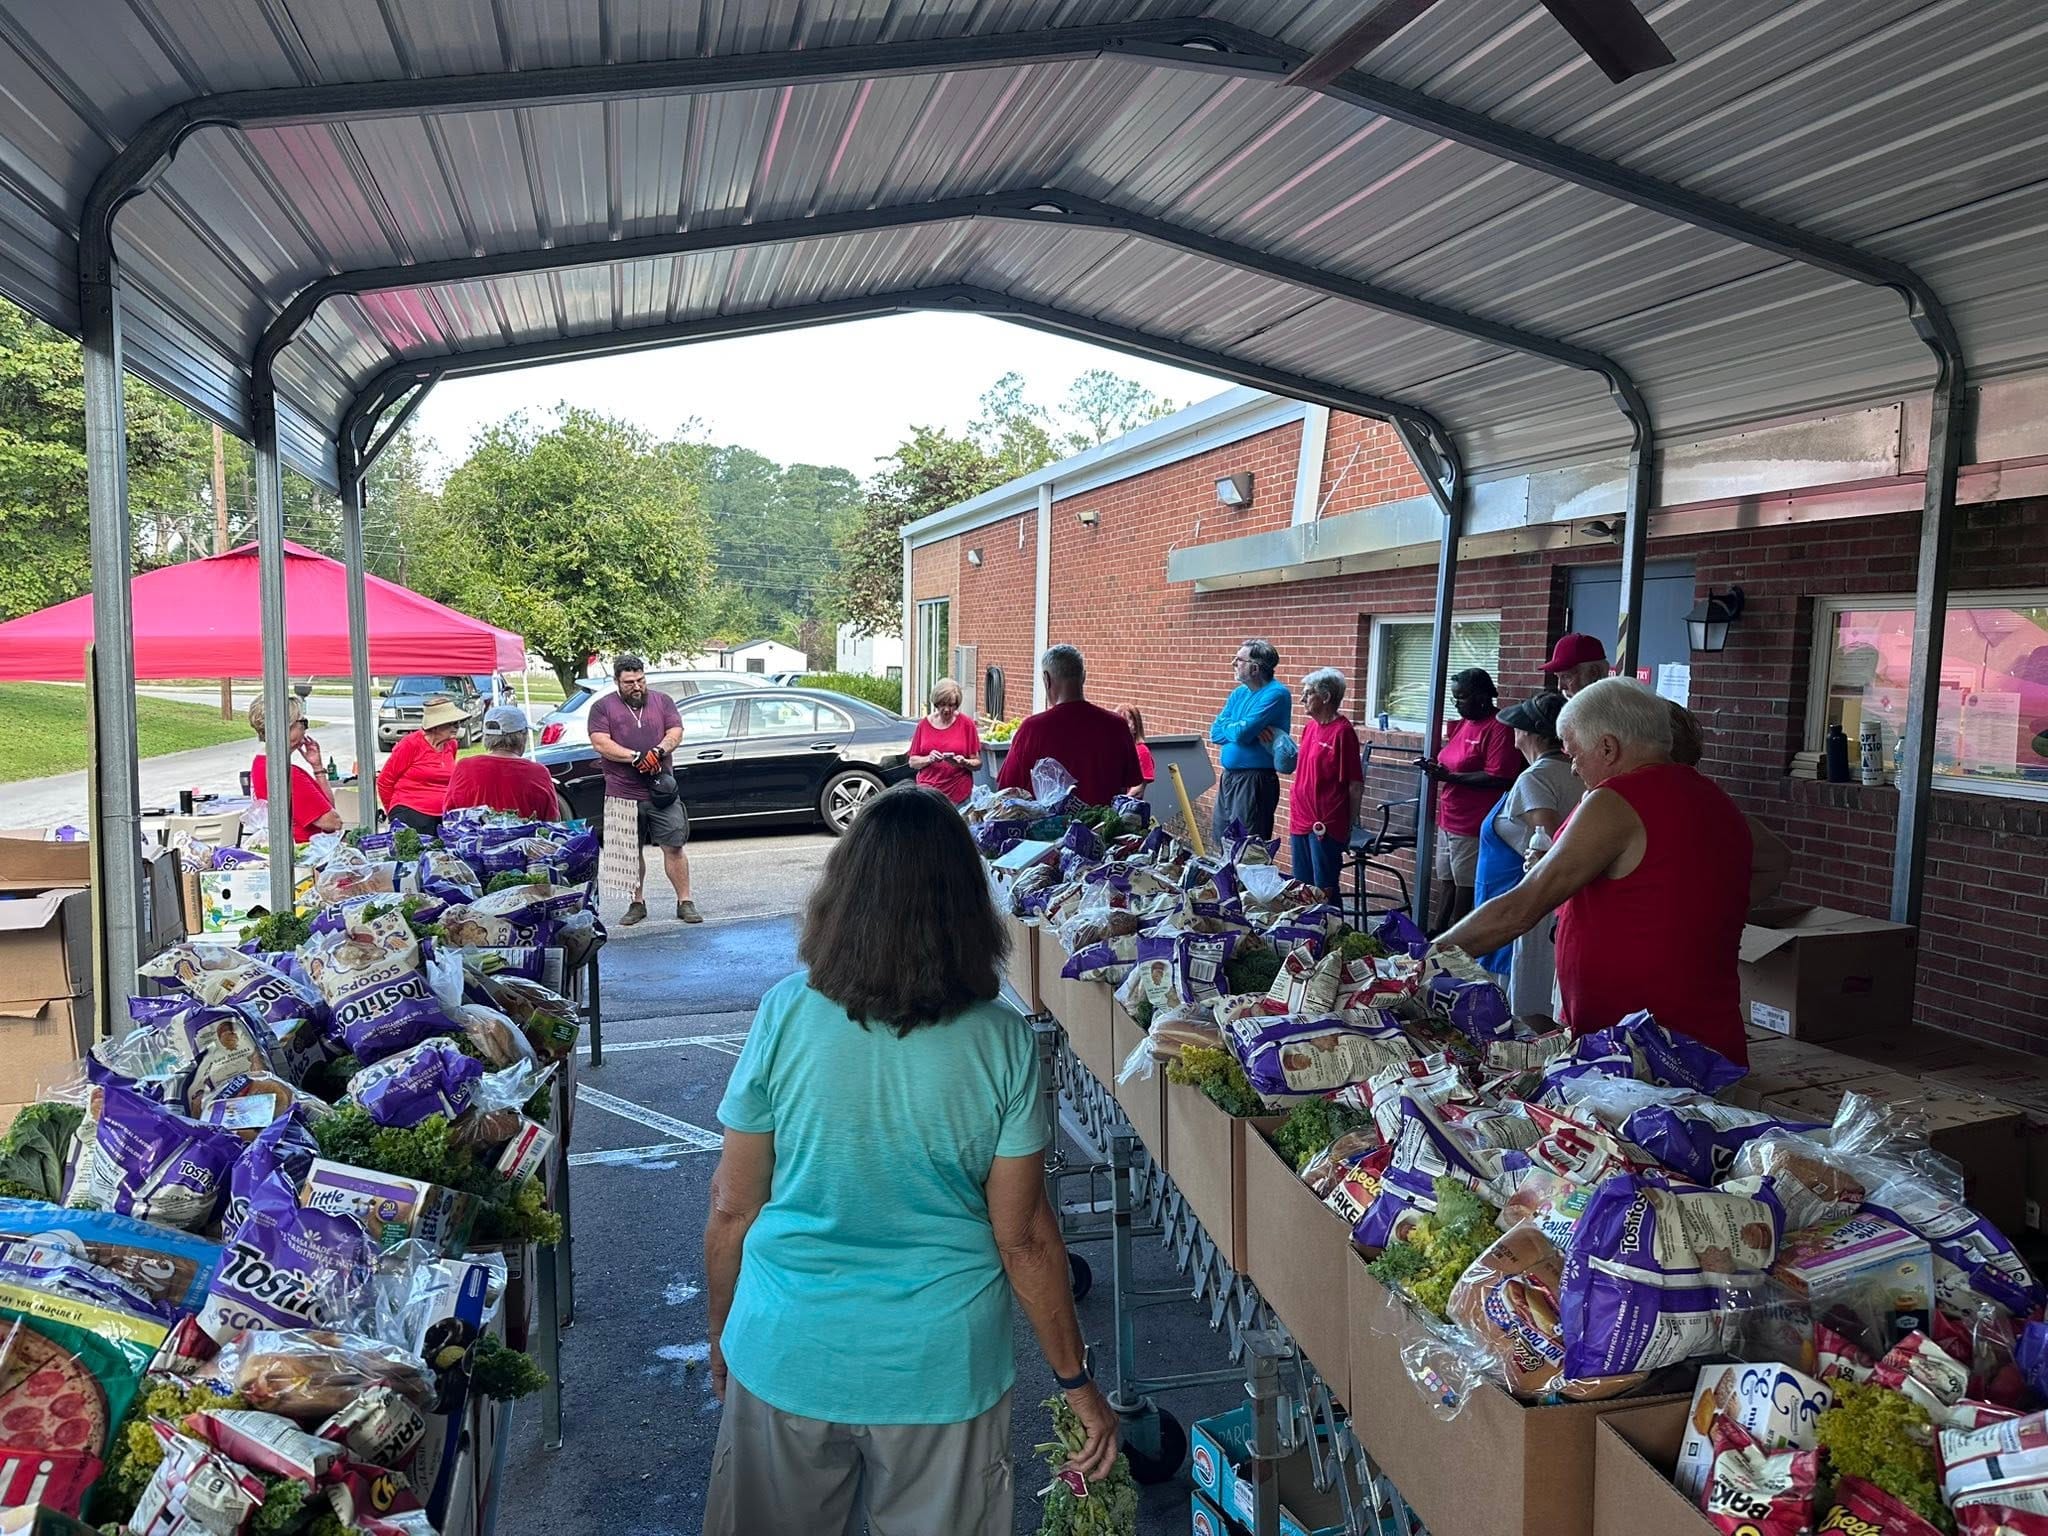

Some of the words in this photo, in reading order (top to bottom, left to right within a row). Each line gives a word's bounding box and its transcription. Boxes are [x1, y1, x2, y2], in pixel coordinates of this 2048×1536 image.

[337, 964, 401, 996] SCOOPS!
[223, 1075, 247, 1099] ATERS
[1542, 1221, 1573, 1236] Bites
[1621, 1191, 1648, 1254] Tostitos
[16, 1298, 33, 1309] you
[33, 1301, 72, 1320] imagine
[73, 1311, 83, 1322] it
[1521, 1327, 1545, 1349] DOG
[1540, 1342, 1564, 1360] HOT
